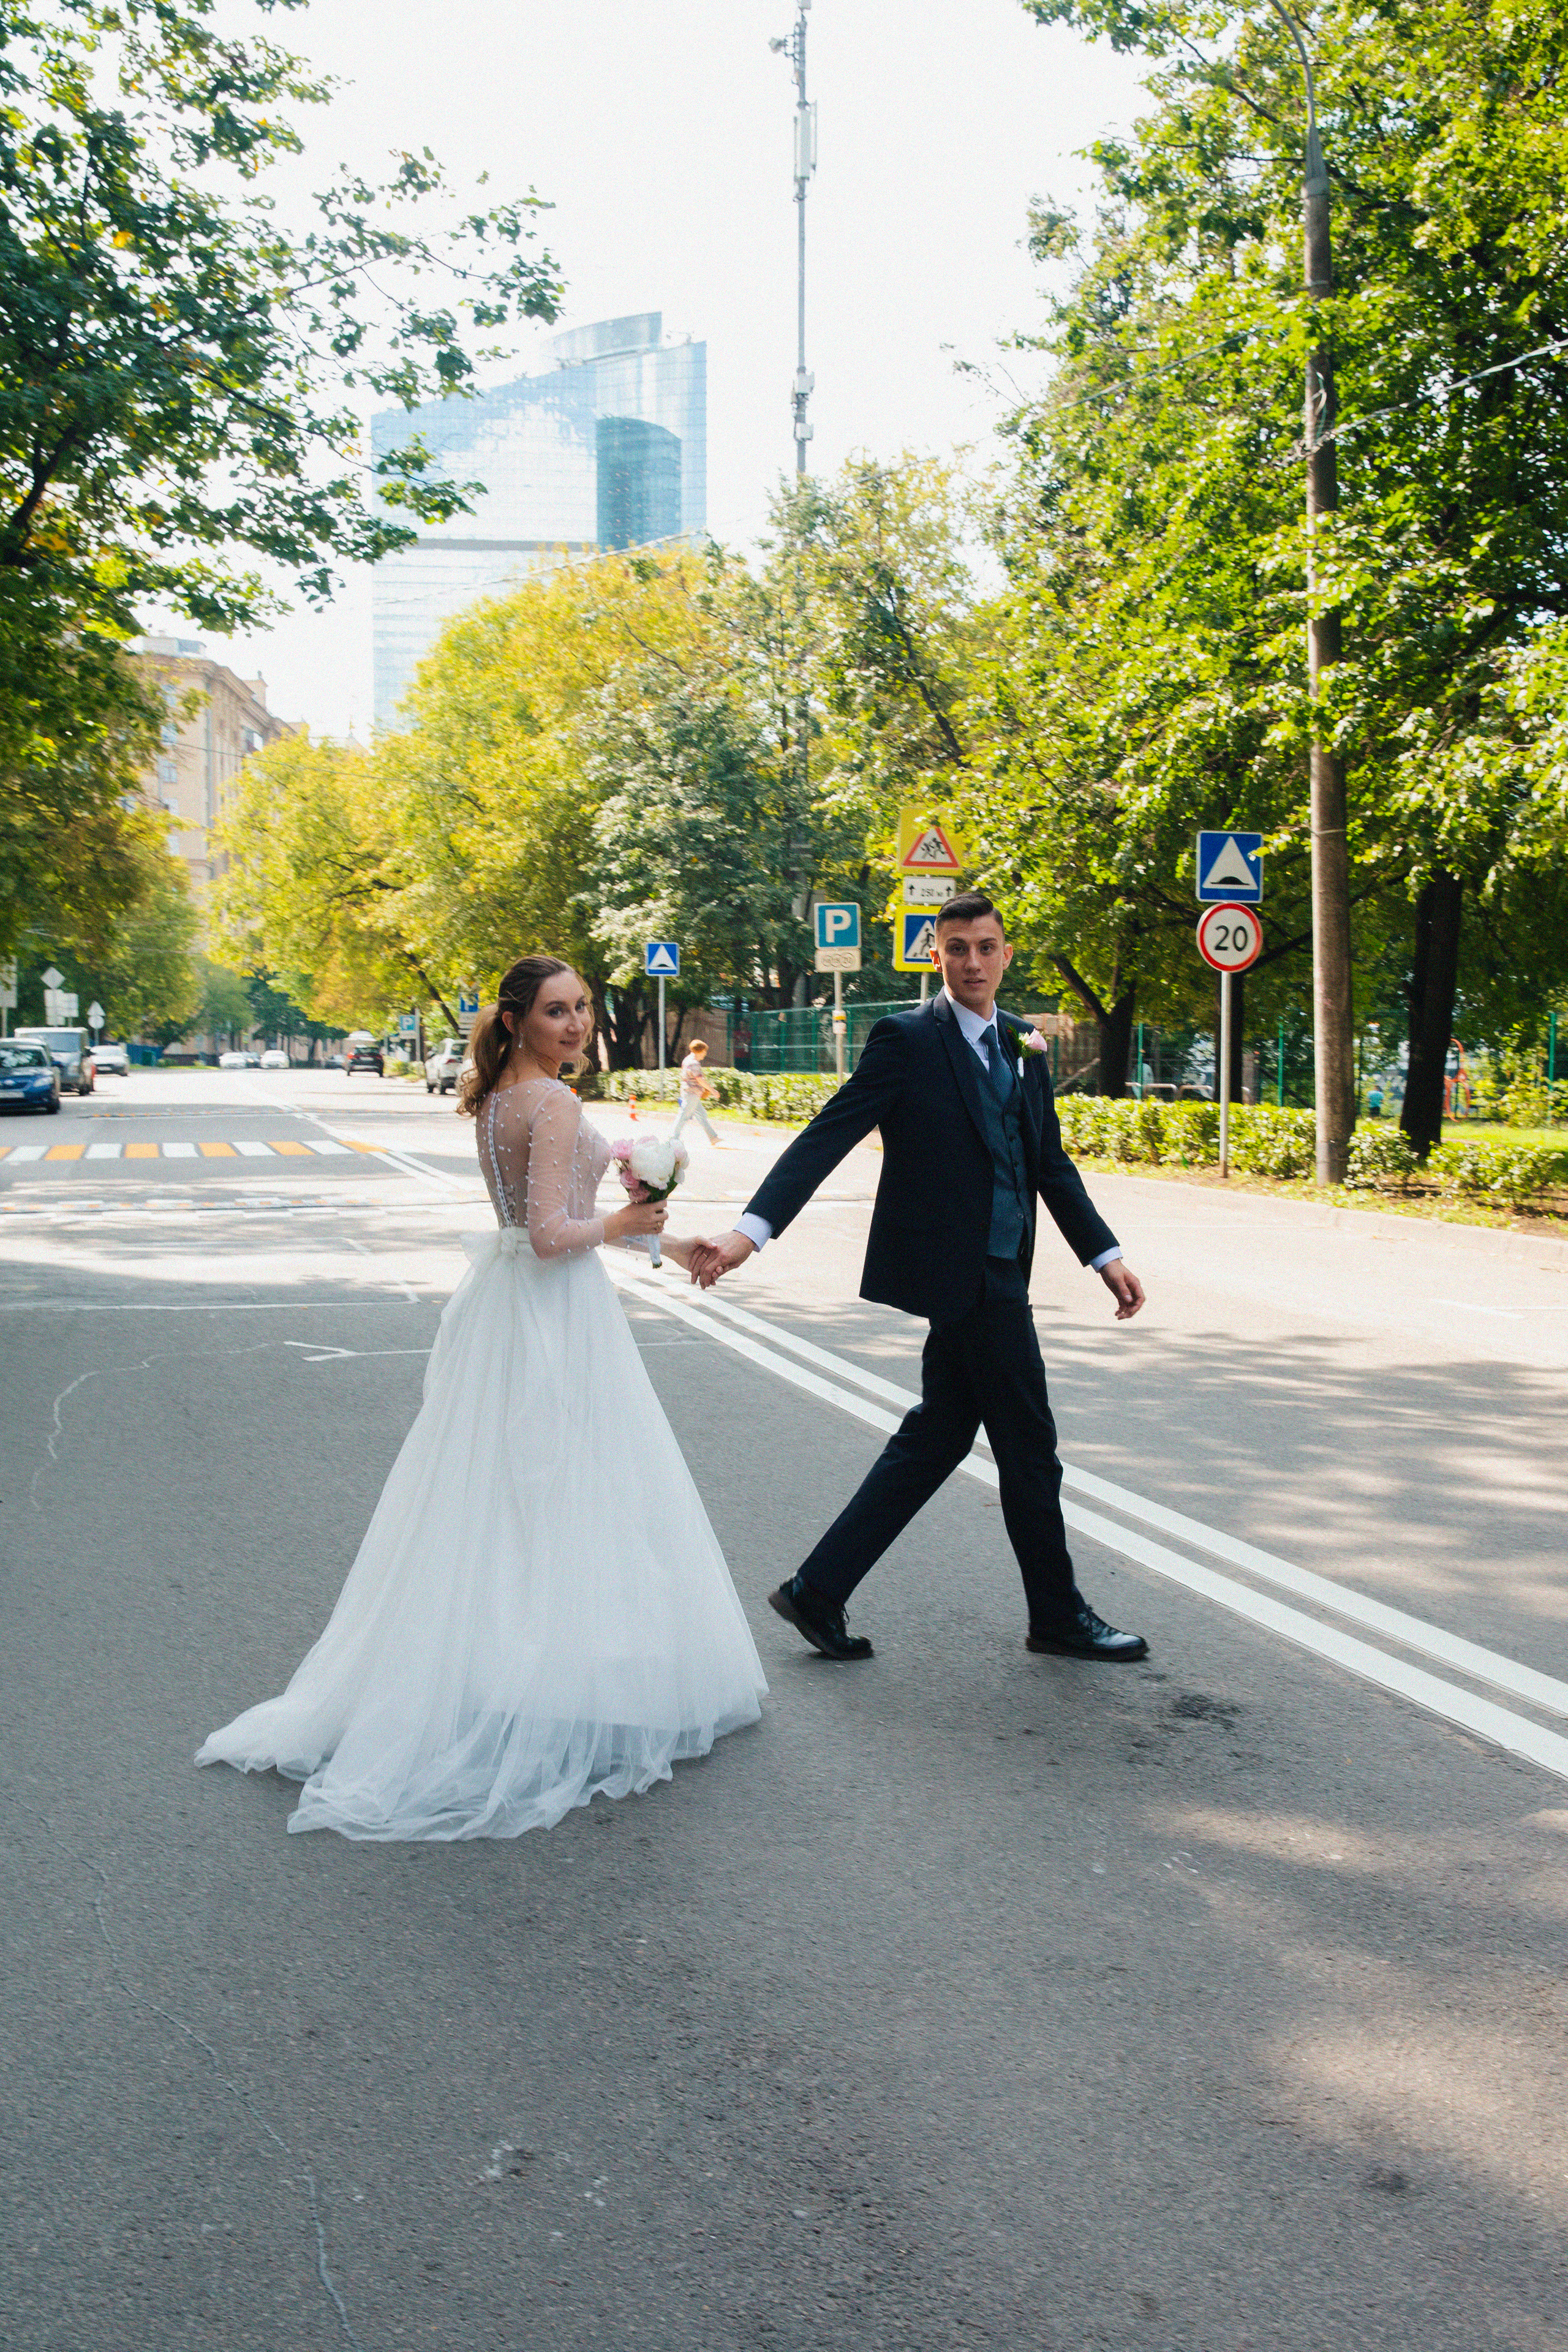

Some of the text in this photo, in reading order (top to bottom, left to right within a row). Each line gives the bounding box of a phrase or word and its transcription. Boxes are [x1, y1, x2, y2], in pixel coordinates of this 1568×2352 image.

[825, 909, 851, 943] P
[1215, 925, 1248, 952] 20
[402, 1017, 413, 1030] P
